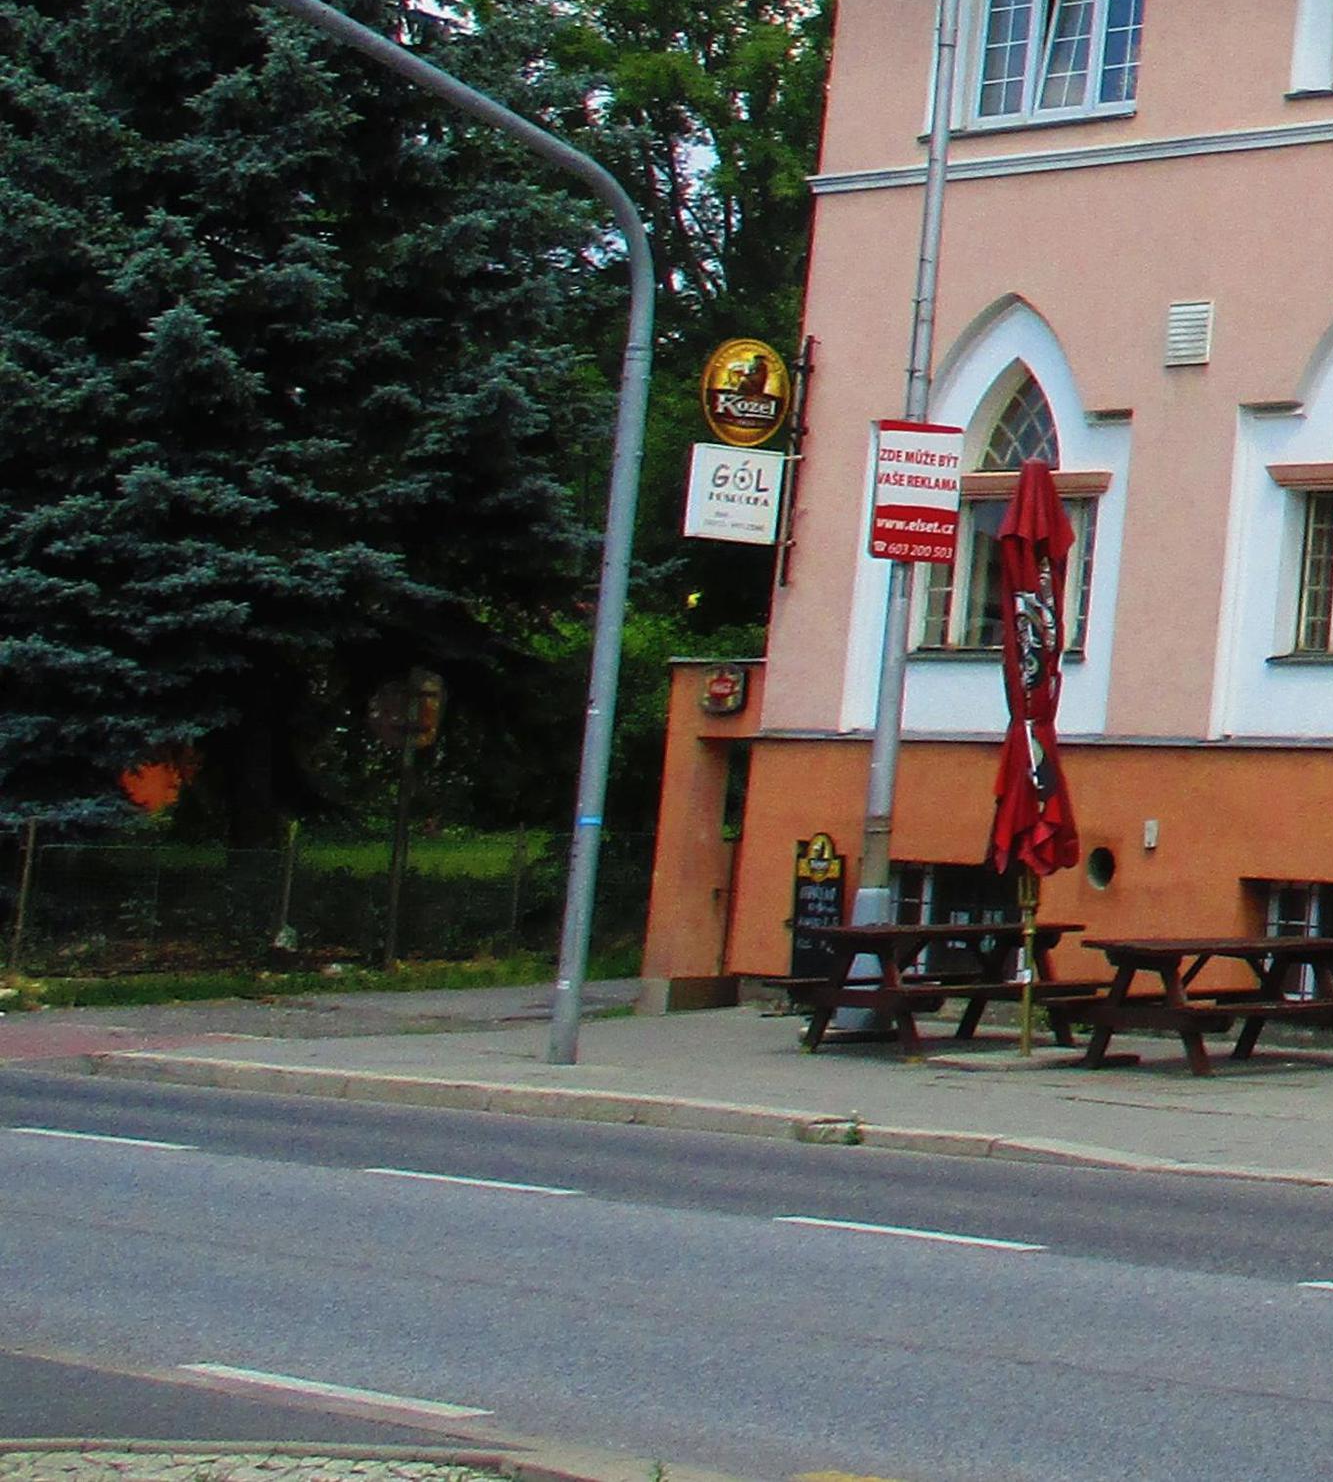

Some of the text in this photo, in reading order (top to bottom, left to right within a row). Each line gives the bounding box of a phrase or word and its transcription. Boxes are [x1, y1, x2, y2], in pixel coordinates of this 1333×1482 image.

[715, 393, 776, 418] Kozel
[879, 448, 959, 468] ZDE MŮŽE BÝT
[712, 460, 770, 492] GÓL
[877, 471, 958, 491] VAŠE REKLAMA
[876, 518, 955, 535] www.elset.cz
[887, 543, 910, 556] 603
[933, 546, 953, 558] 503
